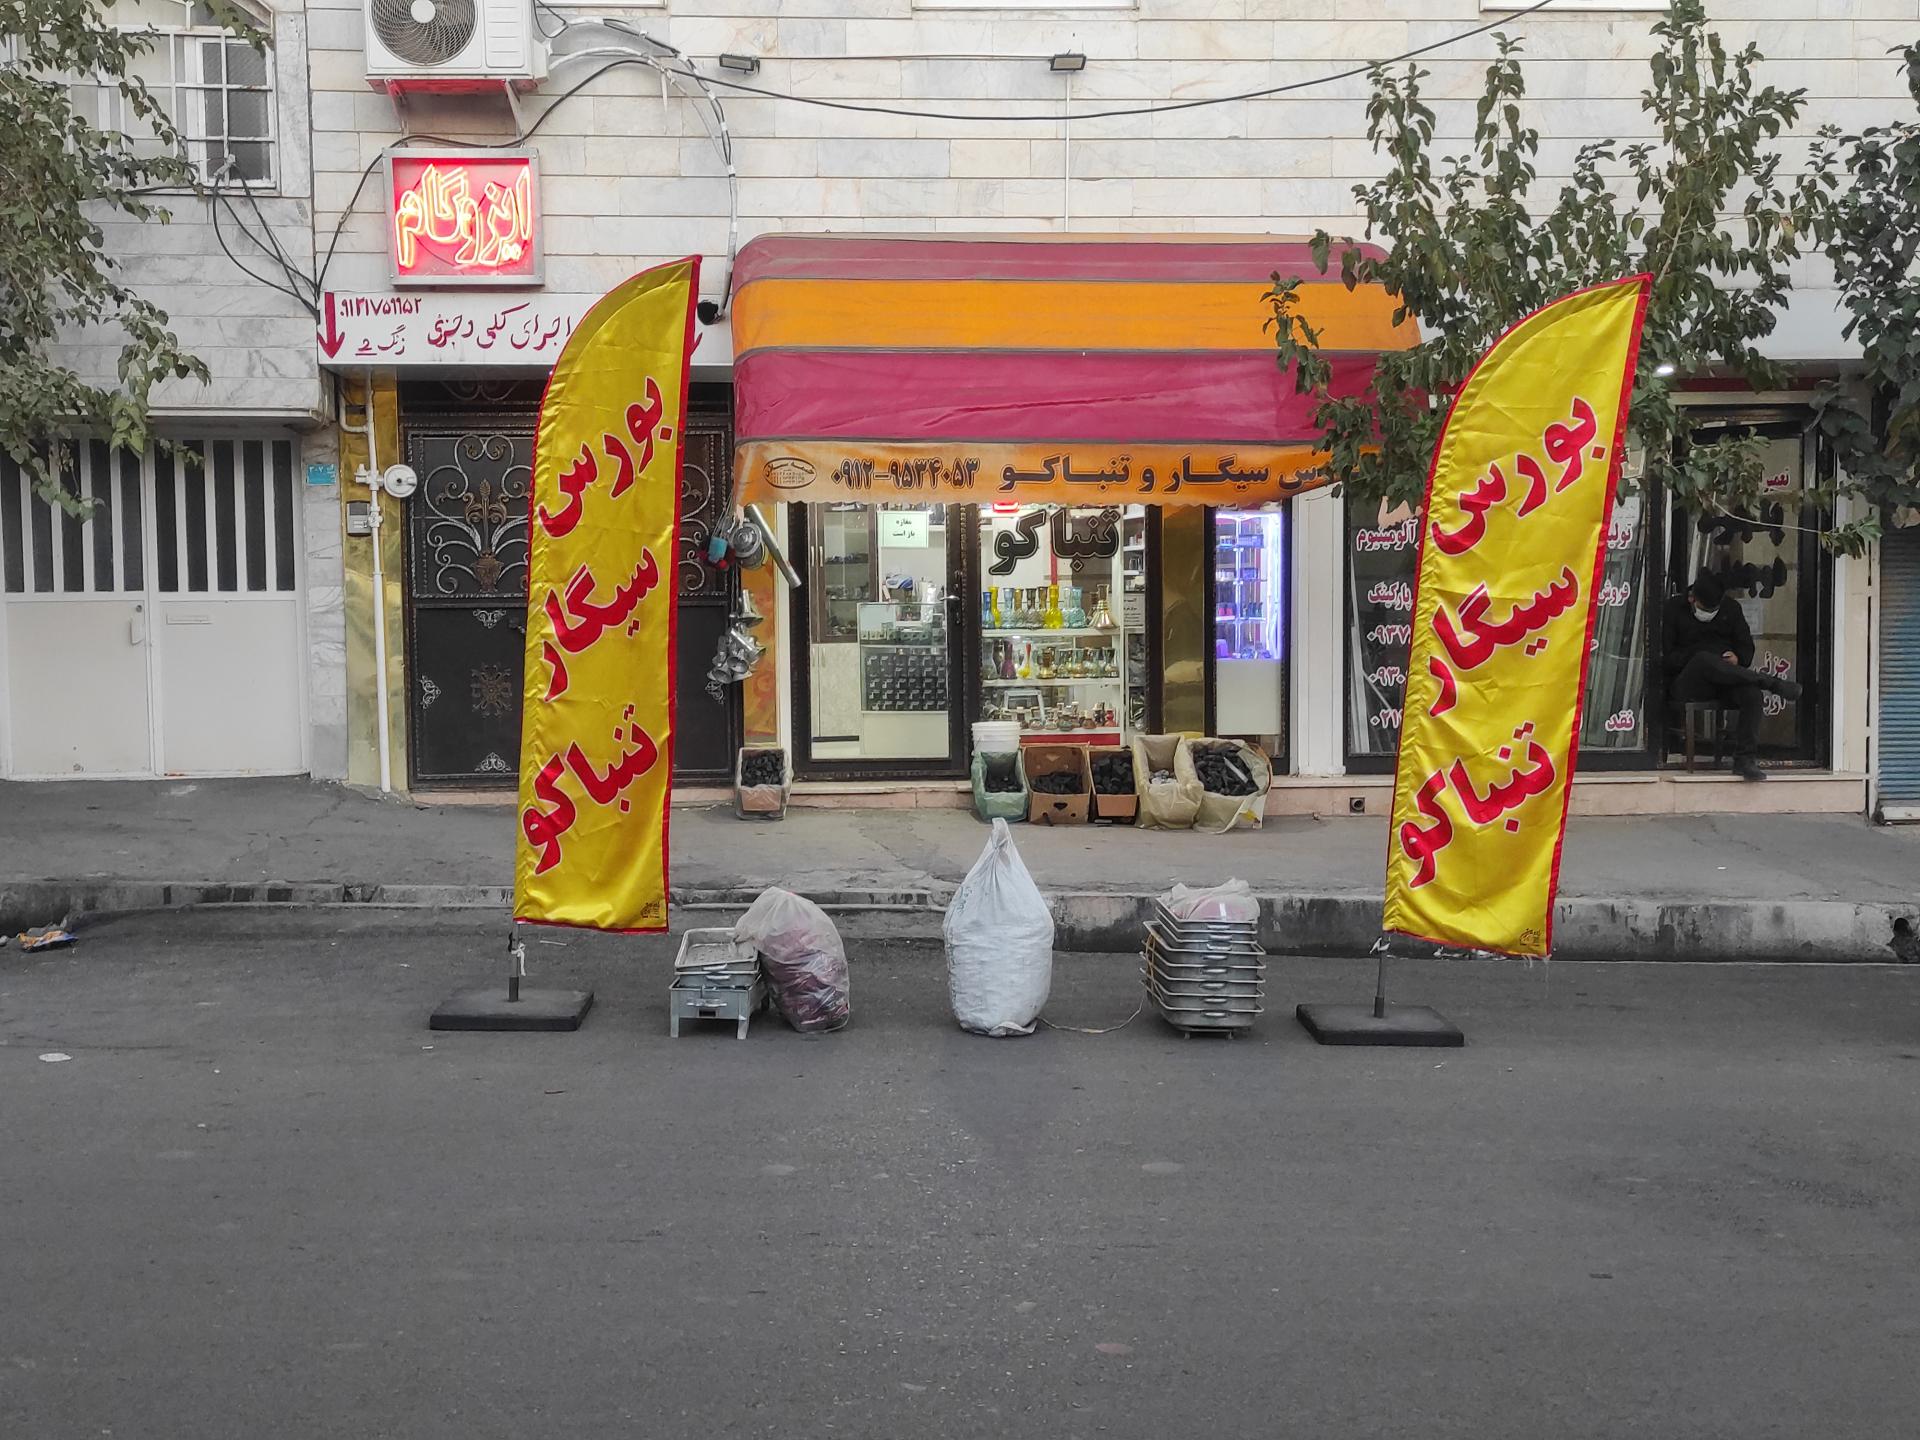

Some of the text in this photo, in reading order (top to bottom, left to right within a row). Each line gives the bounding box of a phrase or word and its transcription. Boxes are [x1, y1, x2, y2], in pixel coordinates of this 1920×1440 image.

[395, 162, 533, 268] ایزوگام
[377, 324, 406, 355] زنگ
[476, 302, 531, 350] کلی
[538, 376, 673, 539] بورس
[997, 453, 1134, 494] تنباکو
[1163, 453, 1270, 494] سیگار
[1431, 396, 1606, 557] بورس
[1137, 467, 1158, 494] و
[988, 507, 1121, 576] تنباکو
[1356, 518, 1419, 551] آلومینیوم
[1367, 580, 1413, 611] پارکینگ
[1597, 579, 1631, 607] فروش
[543, 546, 660, 703] سیگار
[1366, 624, 1411, 645] ۰۹۳۷
[1429, 565, 1580, 718] سیگار
[1605, 709, 1635, 732] نقد
[522, 703, 658, 876] تنباکو
[1400, 720, 1556, 888] تنباکو
